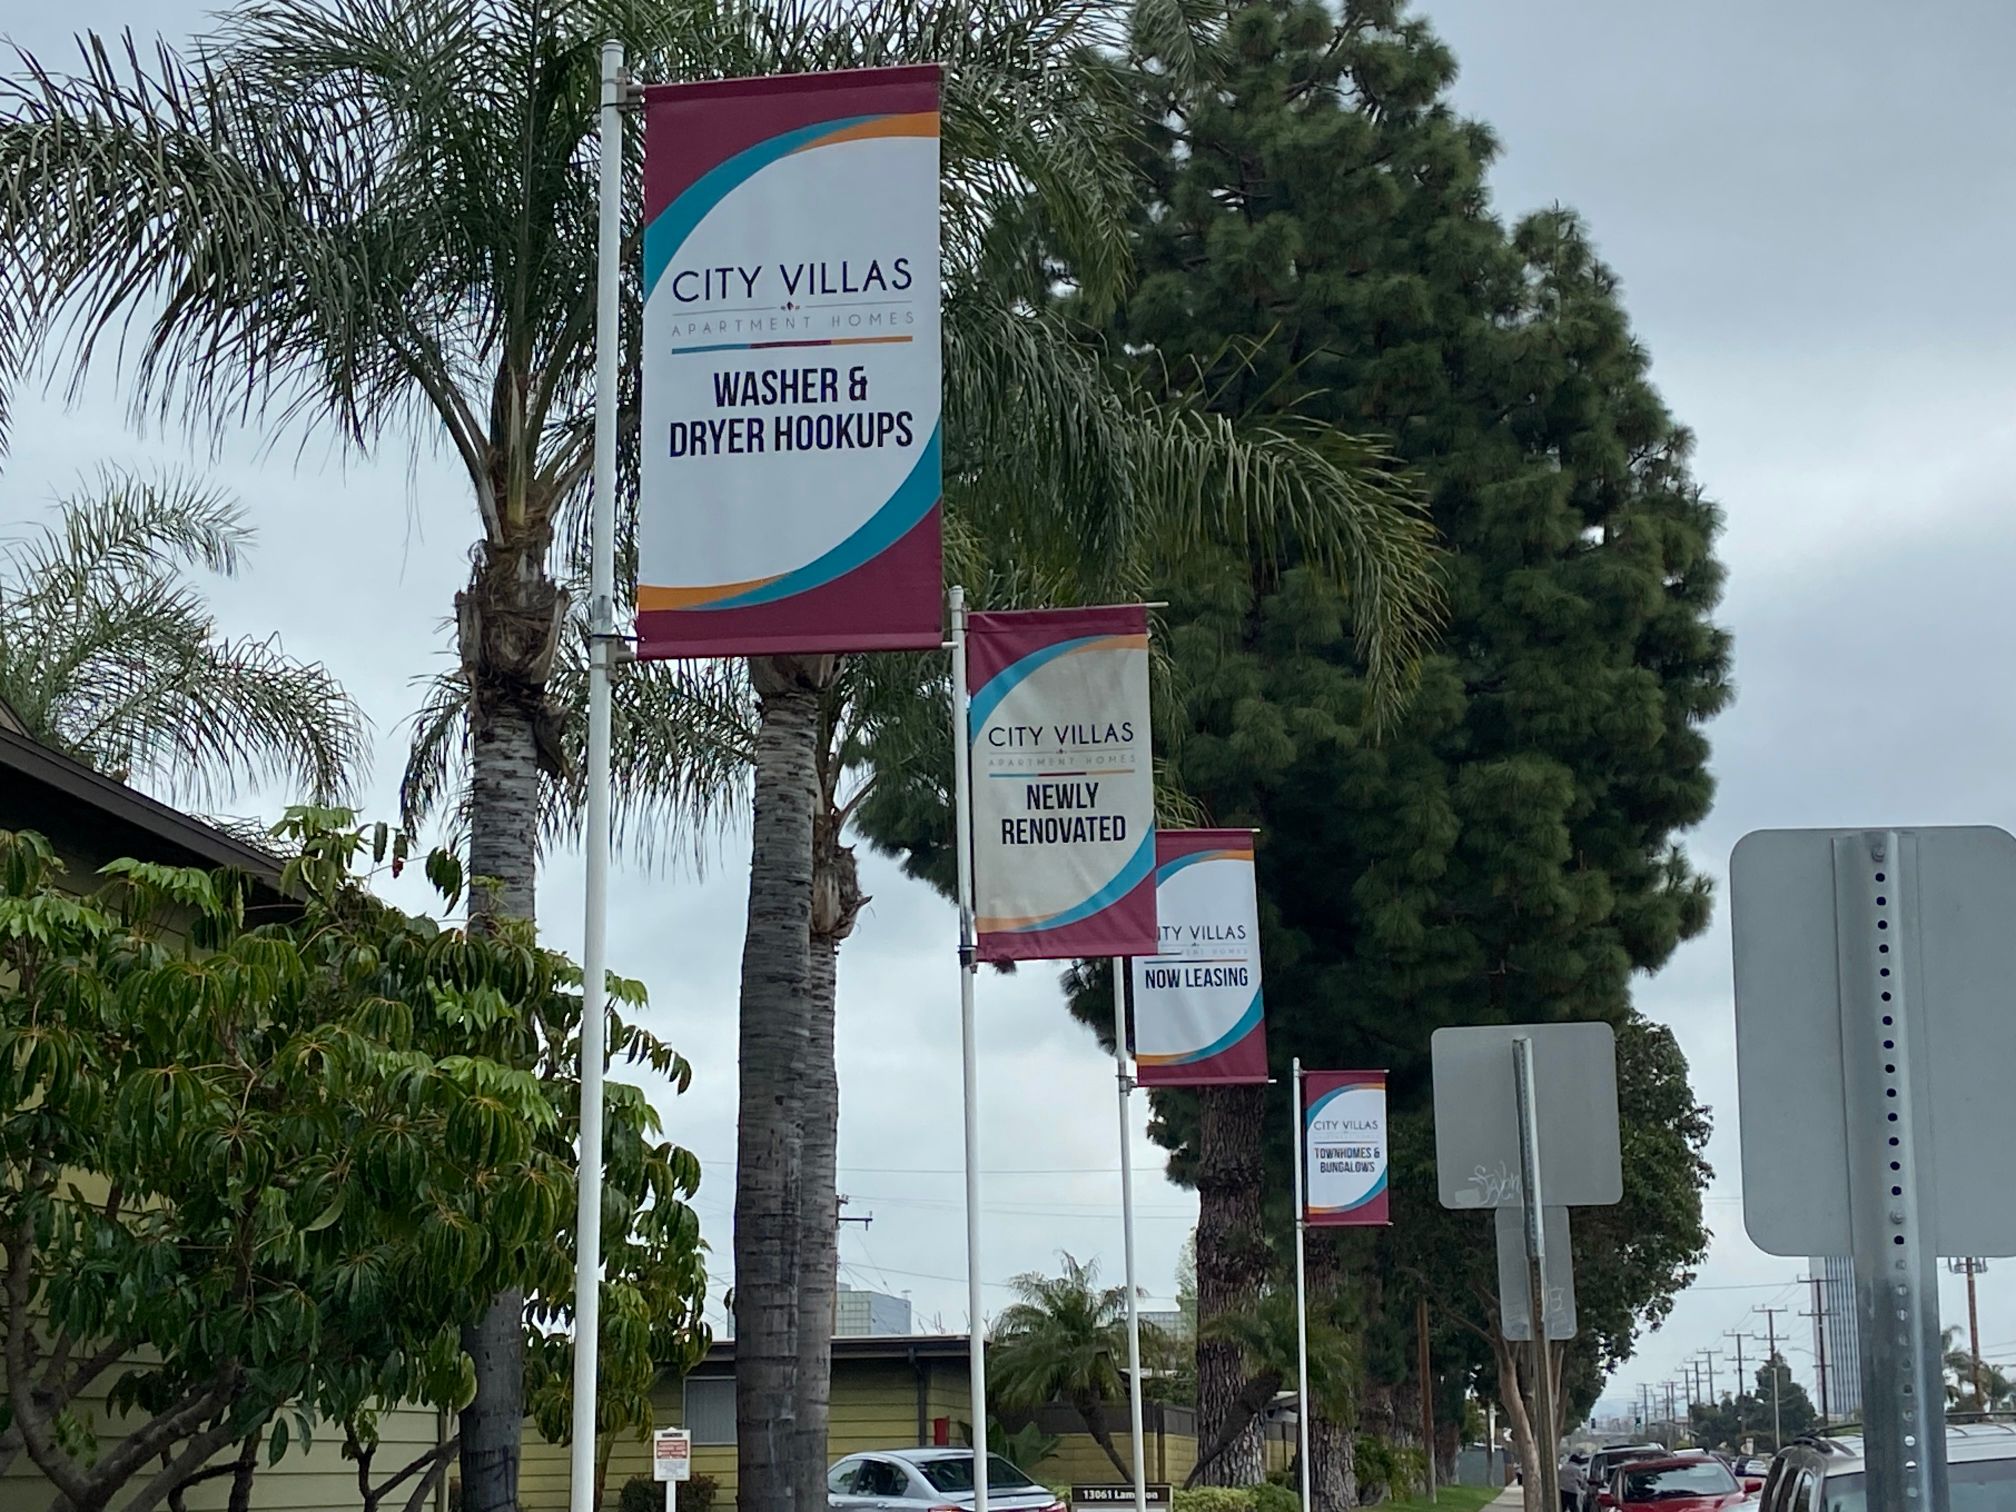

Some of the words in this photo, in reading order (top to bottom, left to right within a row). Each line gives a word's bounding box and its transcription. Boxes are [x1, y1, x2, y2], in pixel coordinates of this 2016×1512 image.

[672, 264, 763, 303] CITY
[778, 257, 913, 296] VILLAS
[671, 315, 812, 337] APARTMENT
[831, 311, 915, 328] HOMES
[713, 367, 838, 408] WASHER
[848, 365, 868, 401] &
[669, 417, 765, 458] DRYER
[774, 410, 913, 452] HOOKUPS
[988, 726, 1043, 748] CITY
[1054, 721, 1135, 745] VILLAS
[1026, 782, 1099, 811] NEWLY
[1001, 815, 1127, 845] RENOVATED
[1157, 925, 1182, 942] ITY
[1189, 924, 1247, 941] VILLAS
[1145, 968, 1181, 989] NOW
[1185, 966, 1249, 988] LEASING
[1313, 1120, 1338, 1130] CITY
[1343, 1120, 1378, 1130] VILLAS
[1314, 1147, 1371, 1159] TOWNHOMES
[1320, 1161, 1375, 1173] BUNGALOWS
[1083, 1489, 1112, 1499] 13061
[1114, 1489, 1158, 1499] Lamon
